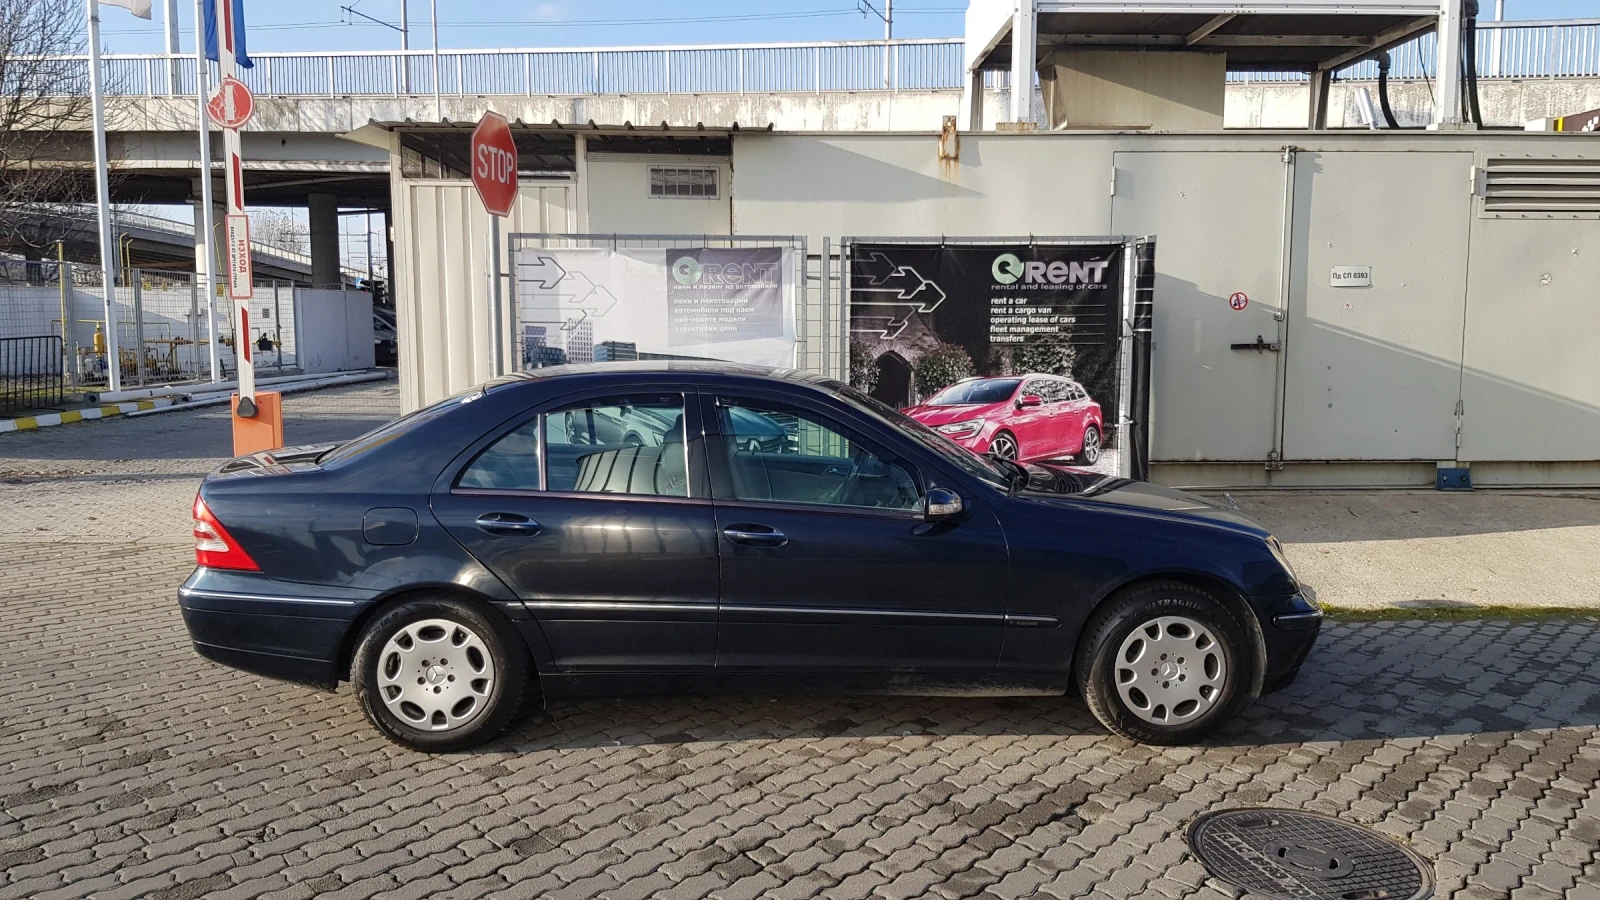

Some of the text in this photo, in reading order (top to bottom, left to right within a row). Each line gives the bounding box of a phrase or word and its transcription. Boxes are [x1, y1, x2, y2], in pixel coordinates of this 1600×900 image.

[477, 143, 514, 185] STOP
[238, 239, 247, 273] ИЗХОД
[1040, 283, 1074, 291] leasing
[700, 298, 748, 306] лекотоварни
[990, 297, 1007, 305] rent
[990, 316, 1027, 325] operating
[1009, 326, 1060, 334] management
